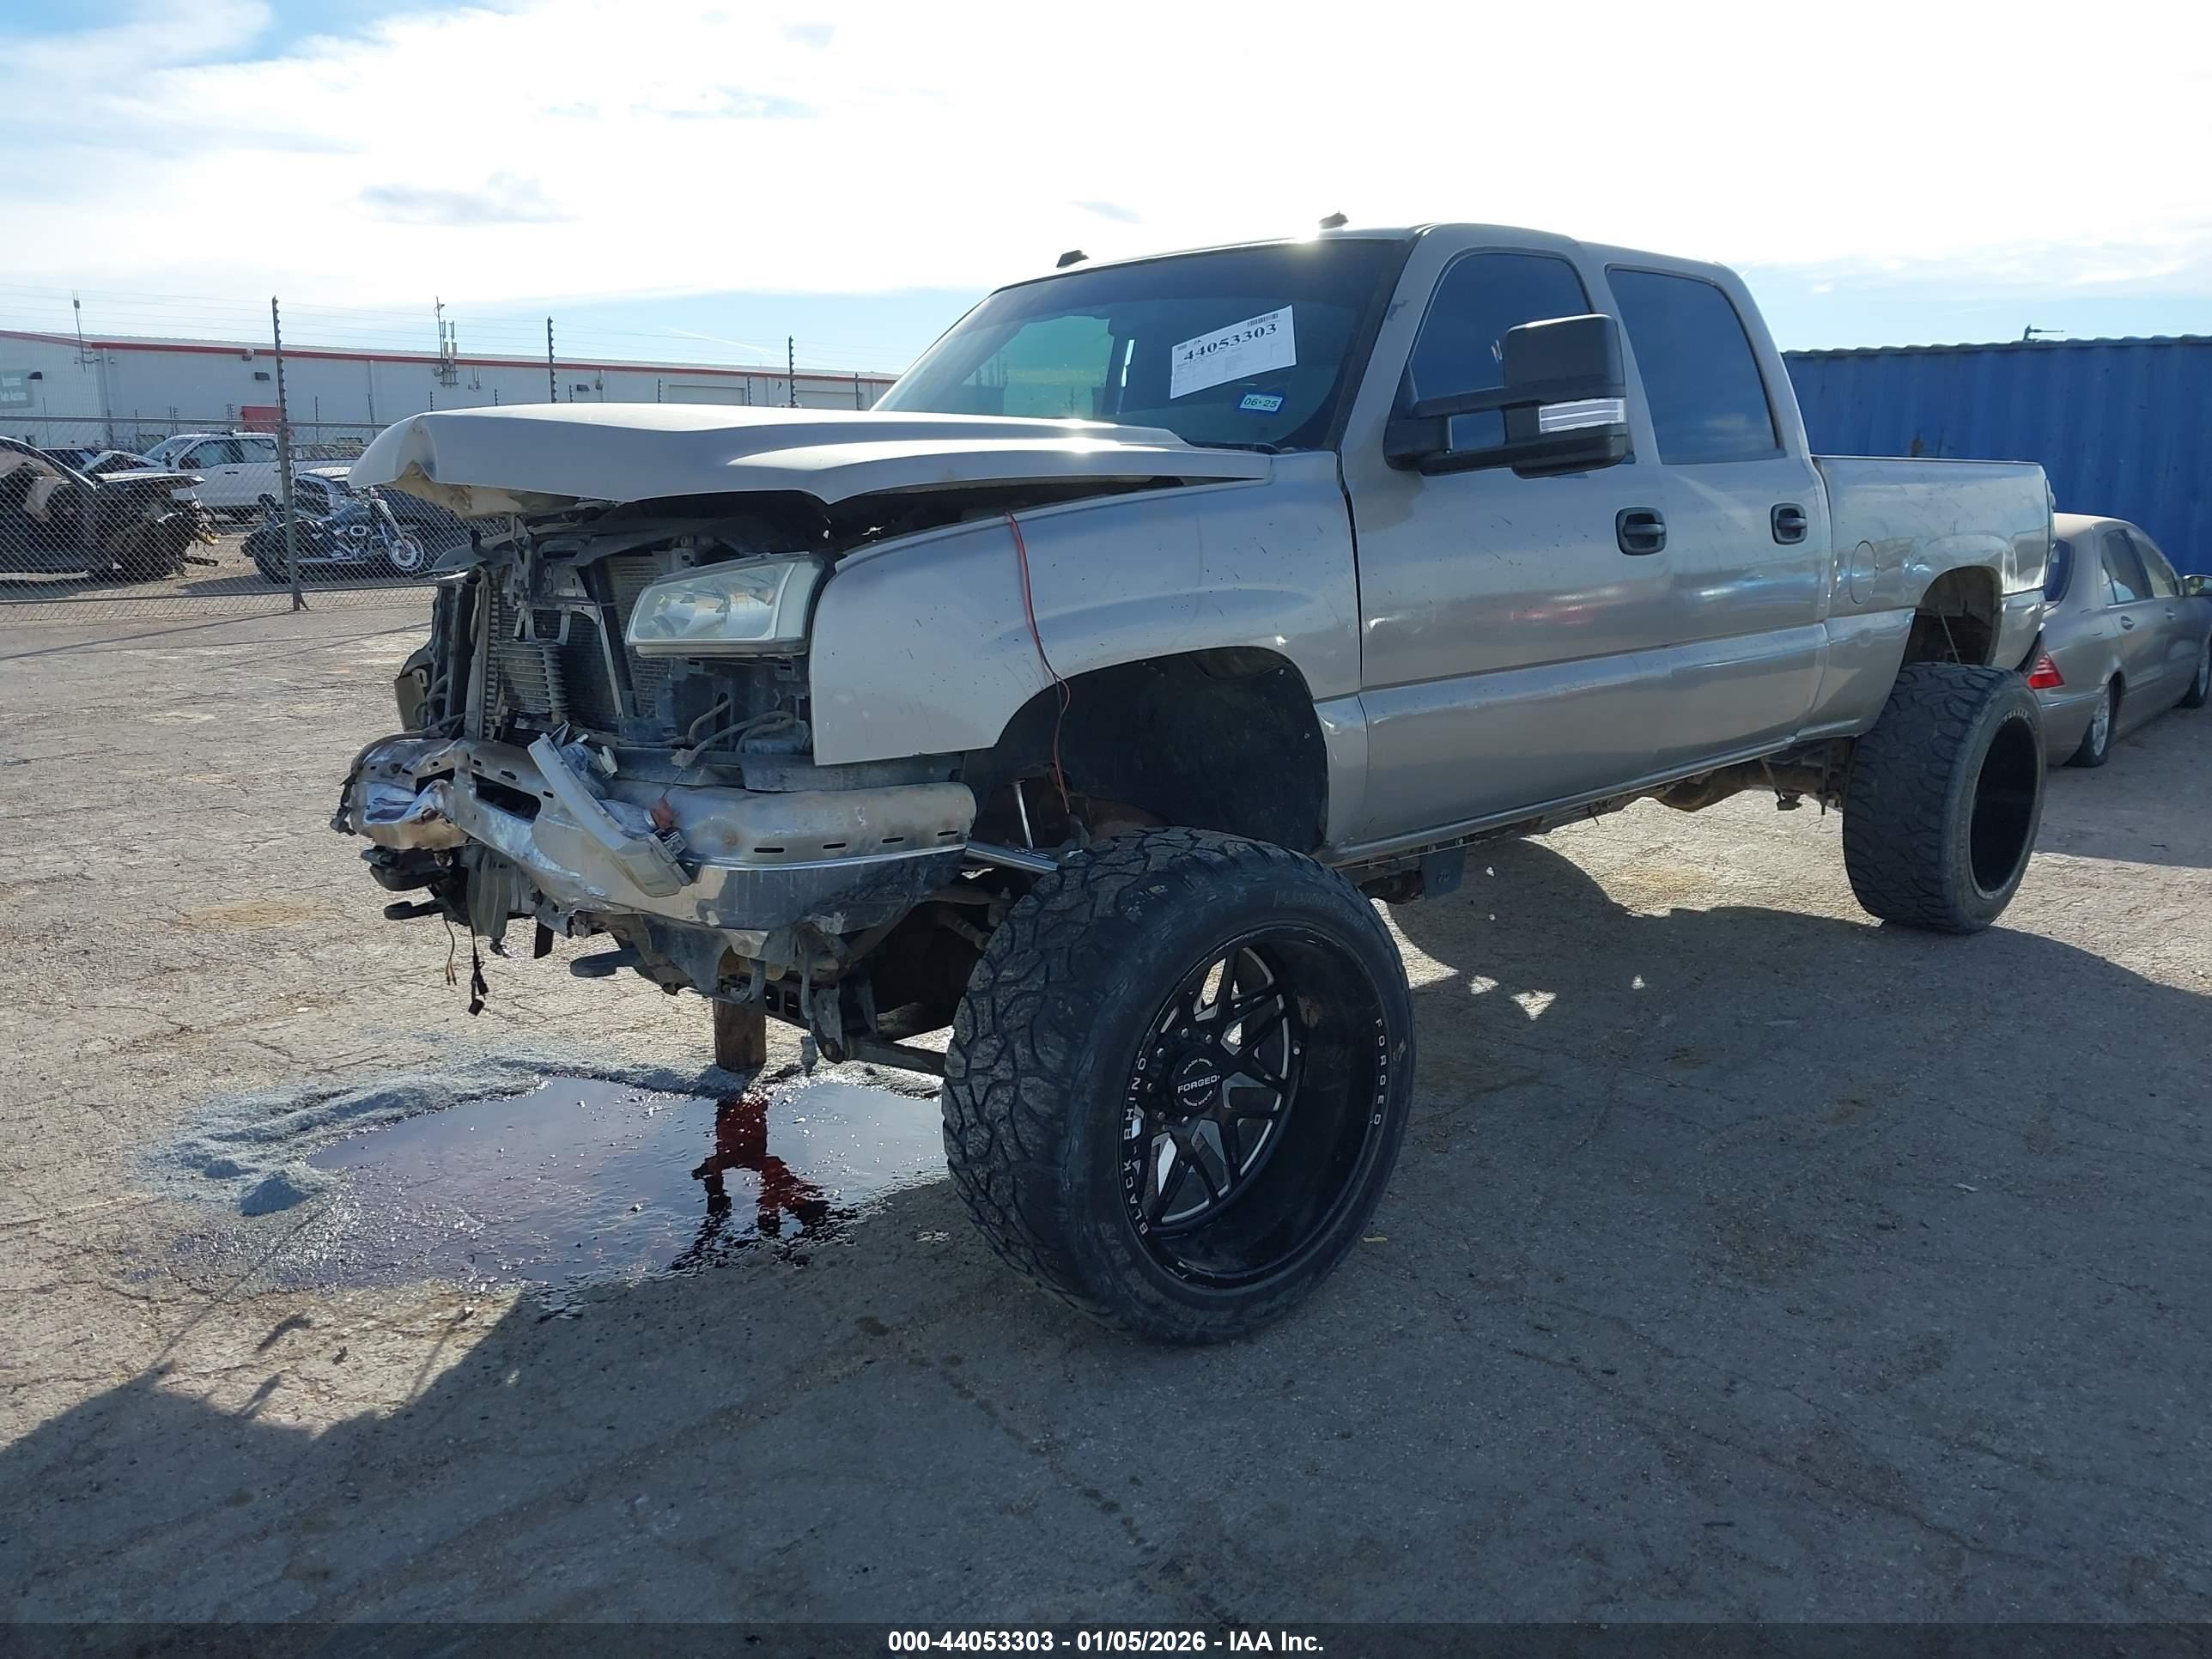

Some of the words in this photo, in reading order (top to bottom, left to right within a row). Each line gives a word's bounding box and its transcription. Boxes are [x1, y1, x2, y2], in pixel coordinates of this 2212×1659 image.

[1183, 323, 1277, 361] 44053303
[1243, 398, 1259, 406] 06
[1262, 399, 1279, 408] 25
[1123, 1057, 1146, 1140] RHINO
[1177, 1074, 1218, 1094] FORGED
[1375, 1018, 1387, 1126] FORGED
[1123, 1159, 1149, 1237] BLACK
